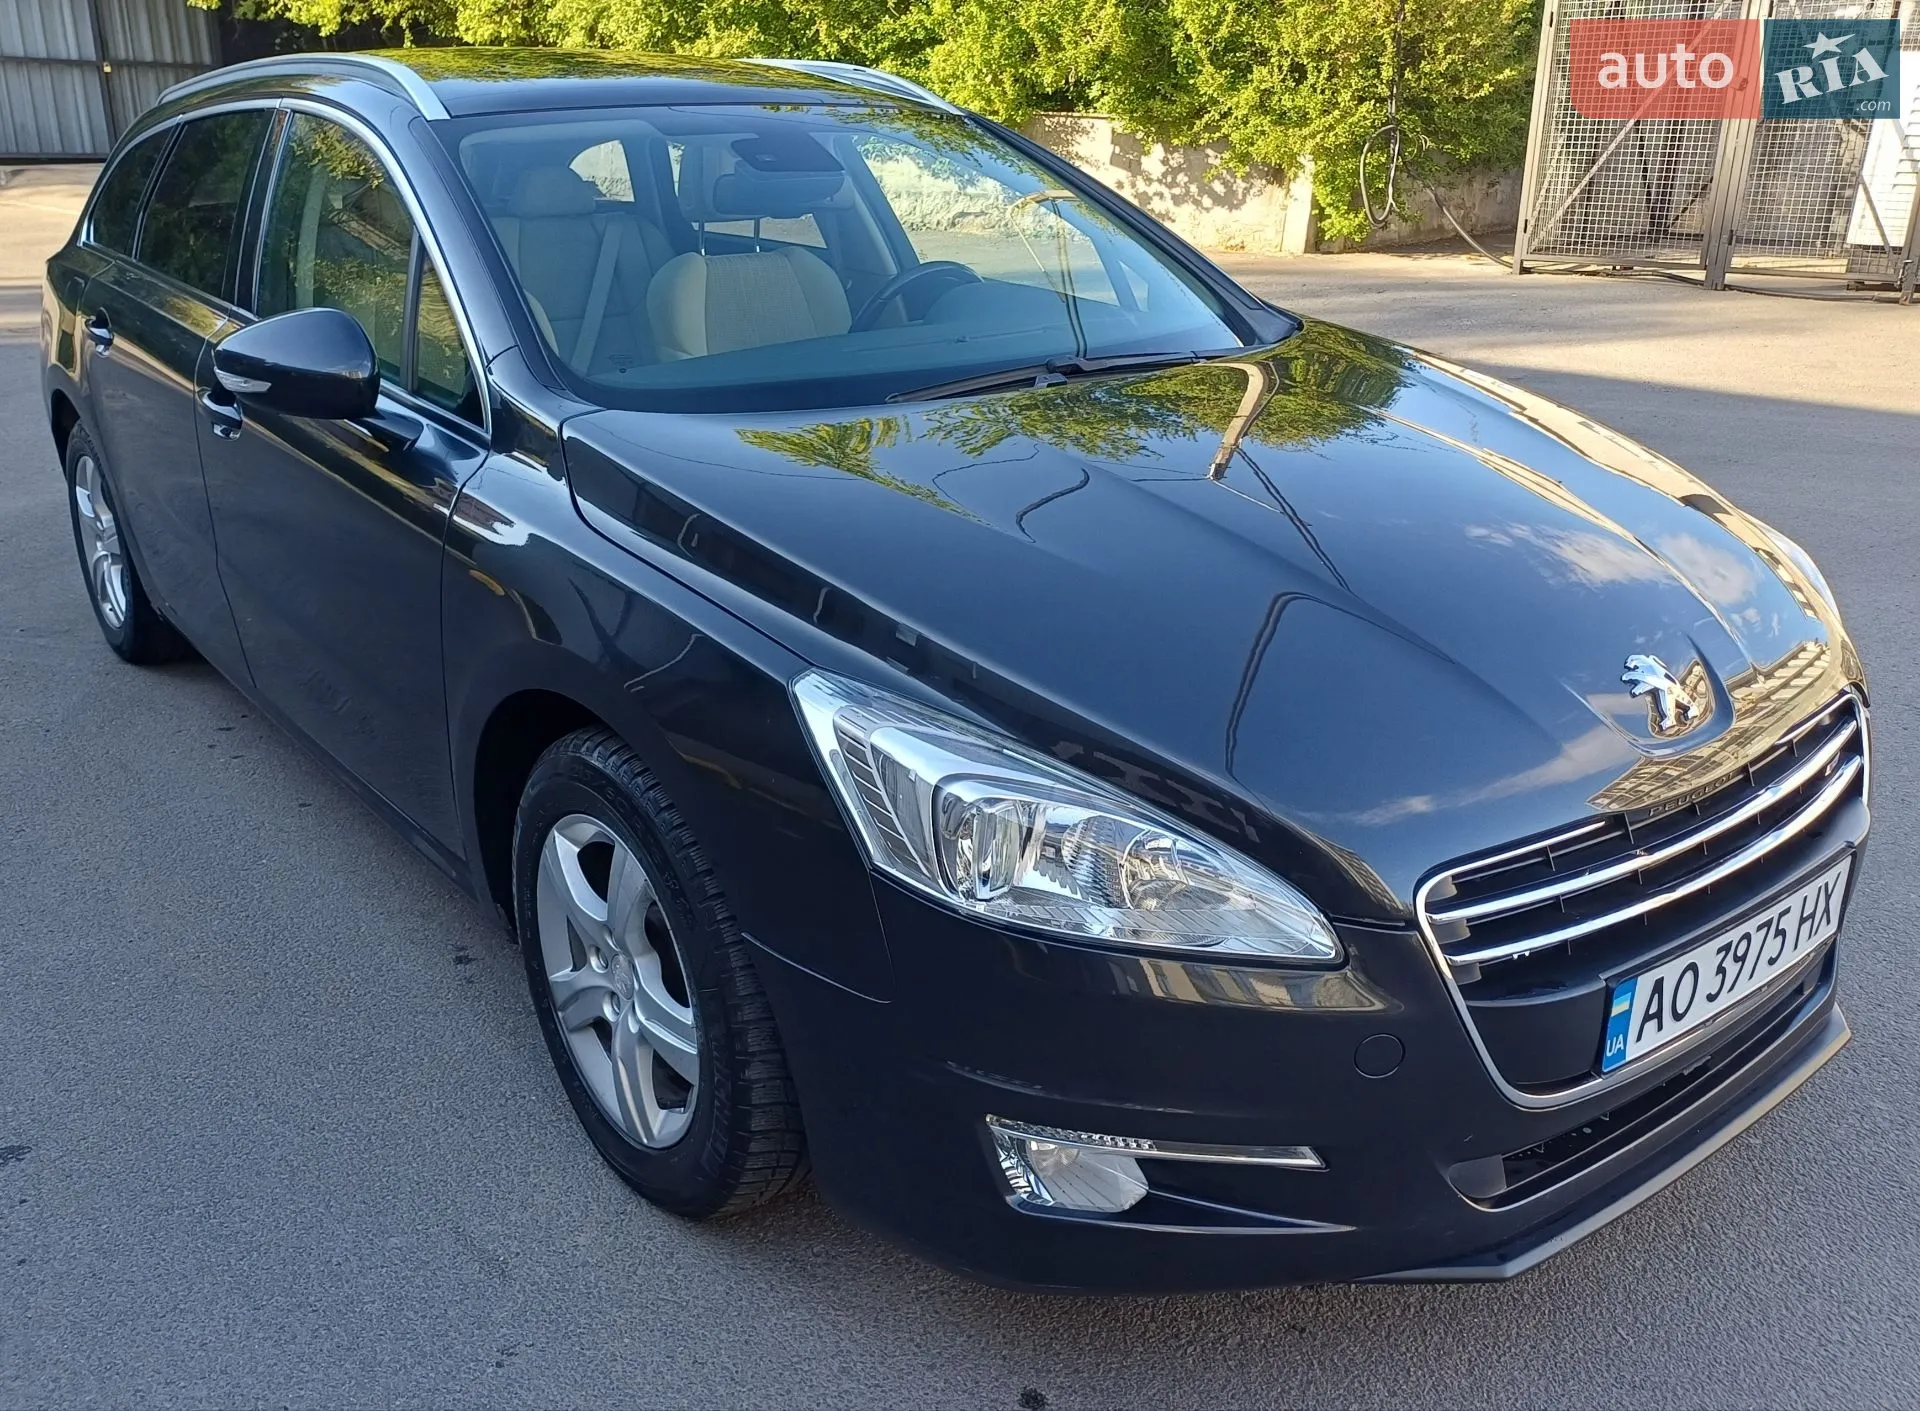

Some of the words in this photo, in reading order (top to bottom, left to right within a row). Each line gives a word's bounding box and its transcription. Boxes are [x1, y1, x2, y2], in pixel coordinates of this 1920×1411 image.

[1649, 772, 1734, 817] PEUGEOT
[1635, 961, 1700, 1043] AO
[1706, 905, 1792, 1003] 3975
[1793, 871, 1842, 952] HX
[1605, 1036, 1624, 1057] UA
